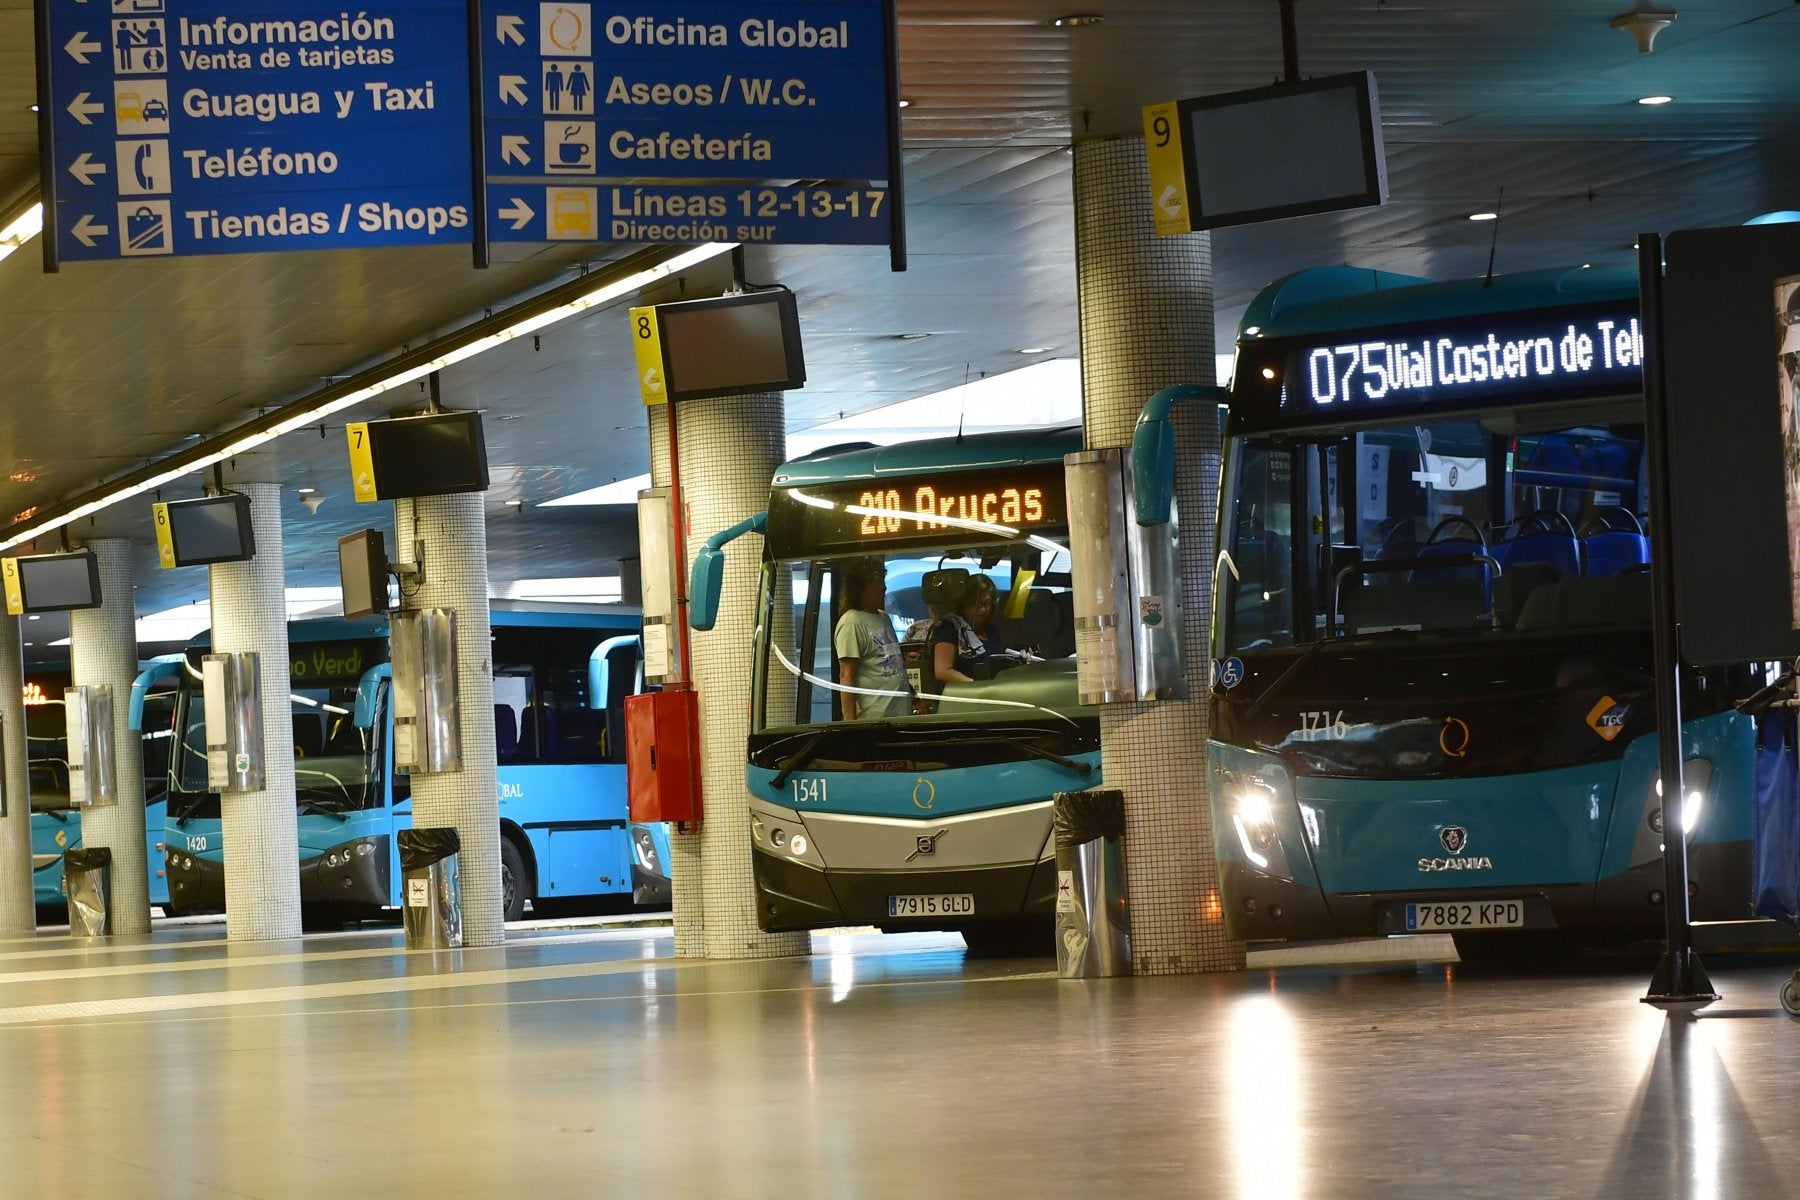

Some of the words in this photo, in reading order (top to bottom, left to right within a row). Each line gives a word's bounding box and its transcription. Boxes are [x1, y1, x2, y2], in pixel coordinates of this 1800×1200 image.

[180, 12, 394, 46] Información
[605, 15, 727, 46] Oficina
[739, 19, 848, 49] Global
[179, 50, 251, 71] Venta
[259, 48, 291, 68] de
[297, 46, 394, 69] tarjetas
[183, 88, 321, 120] Guagua
[334, 90, 354, 118] y
[364, 81, 435, 111] Taxi
[605, 76, 713, 106] Aseos
[719, 75, 732, 104] /
[740, 79, 816, 106] W.C.
[1153, 116, 1170, 147] 9
[609, 131, 772, 161] Cafetería
[183, 147, 338, 178] Teléfono
[612, 189, 727, 217] Líneas
[738, 190, 885, 218] 12-13-17
[185, 207, 330, 239] Tiendas
[338, 203, 352, 233] /
[358, 203, 469, 235] Shops
[611, 220, 728, 240] Dirección
[736, 225, 776, 240] sur
[638, 316, 651, 339] 8
[1310, 342, 1388, 403] 075
[1386, 340, 1433, 389] Vial
[1437, 333, 1554, 385] Costero
[1560, 325, 1593, 371] de
[353, 431, 362, 449] 7
[157, 510, 165, 525] 6
[860, 490, 901, 535] 210
[915, 486, 1042, 530] Arucas
[7, 563, 15, 577] 5
[312, 648, 362, 676] Verd
[1300, 710, 1345, 741] 1716
[1602, 714, 1623, 726] TGC
[792, 778, 827, 802] 1541
[186, 836, 206, 851] 1420
[1418, 856, 1493, 872] SCANIA
[899, 897, 936, 914] 7915
[942, 896, 971, 912] GLD
[1420, 905, 1472, 926] 7882
[1480, 904, 1518, 924] KPD
